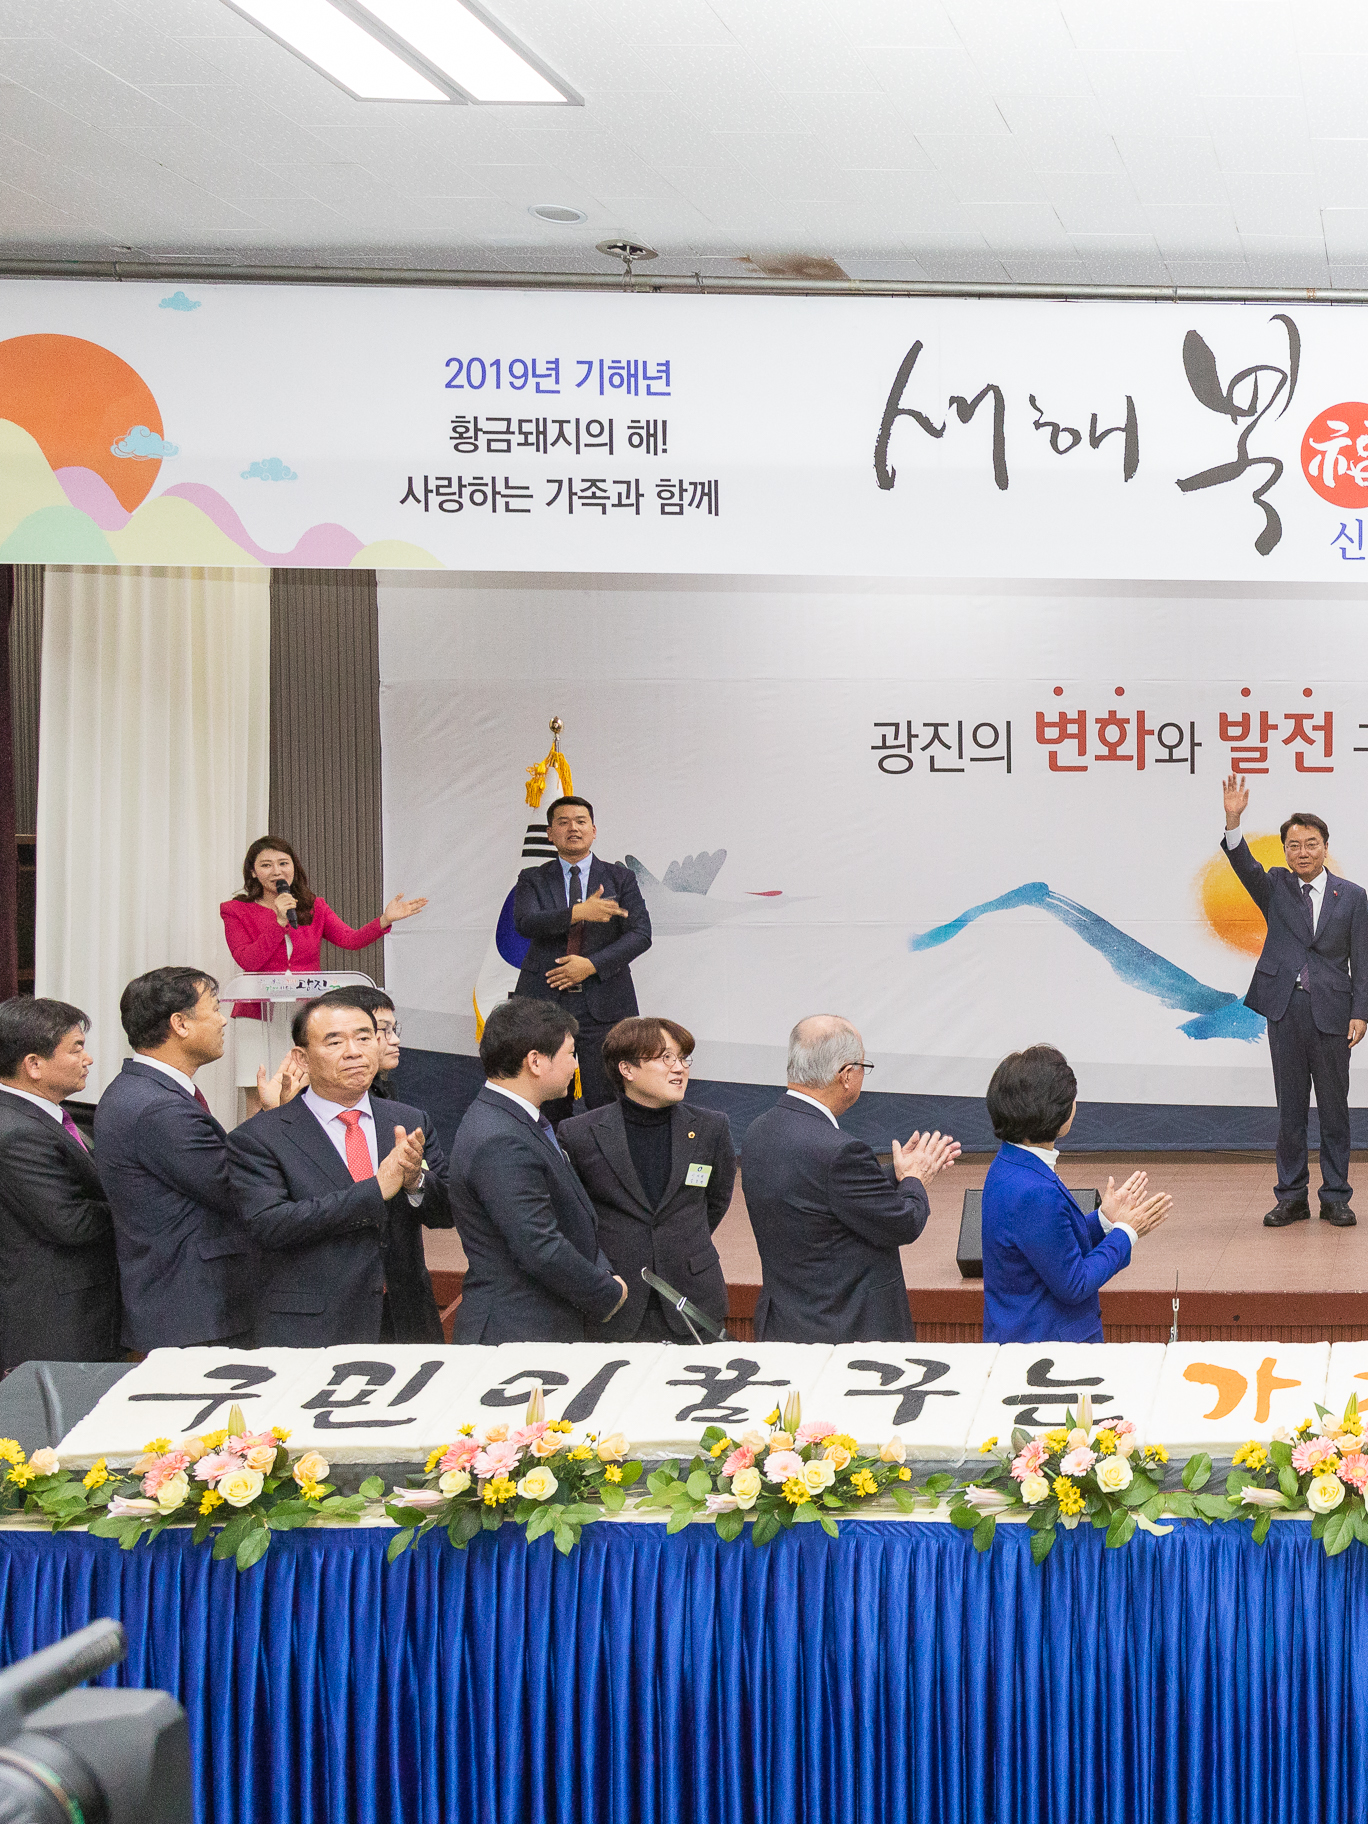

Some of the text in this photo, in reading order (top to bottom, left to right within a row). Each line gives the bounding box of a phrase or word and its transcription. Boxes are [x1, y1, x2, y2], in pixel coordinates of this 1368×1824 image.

[445, 358, 671, 396] 2019년 기해년
[450, 416, 667, 455] 황금돼지의 해!
[874, 340, 1139, 491] 새해
[1175, 314, 1302, 556] 복
[400, 475, 718, 516] 사랑하는 가족과 함께
[871, 720, 1011, 774] 광진의
[1036, 710, 1202, 774] 변화와
[1219, 711, 1333, 774] 발전
